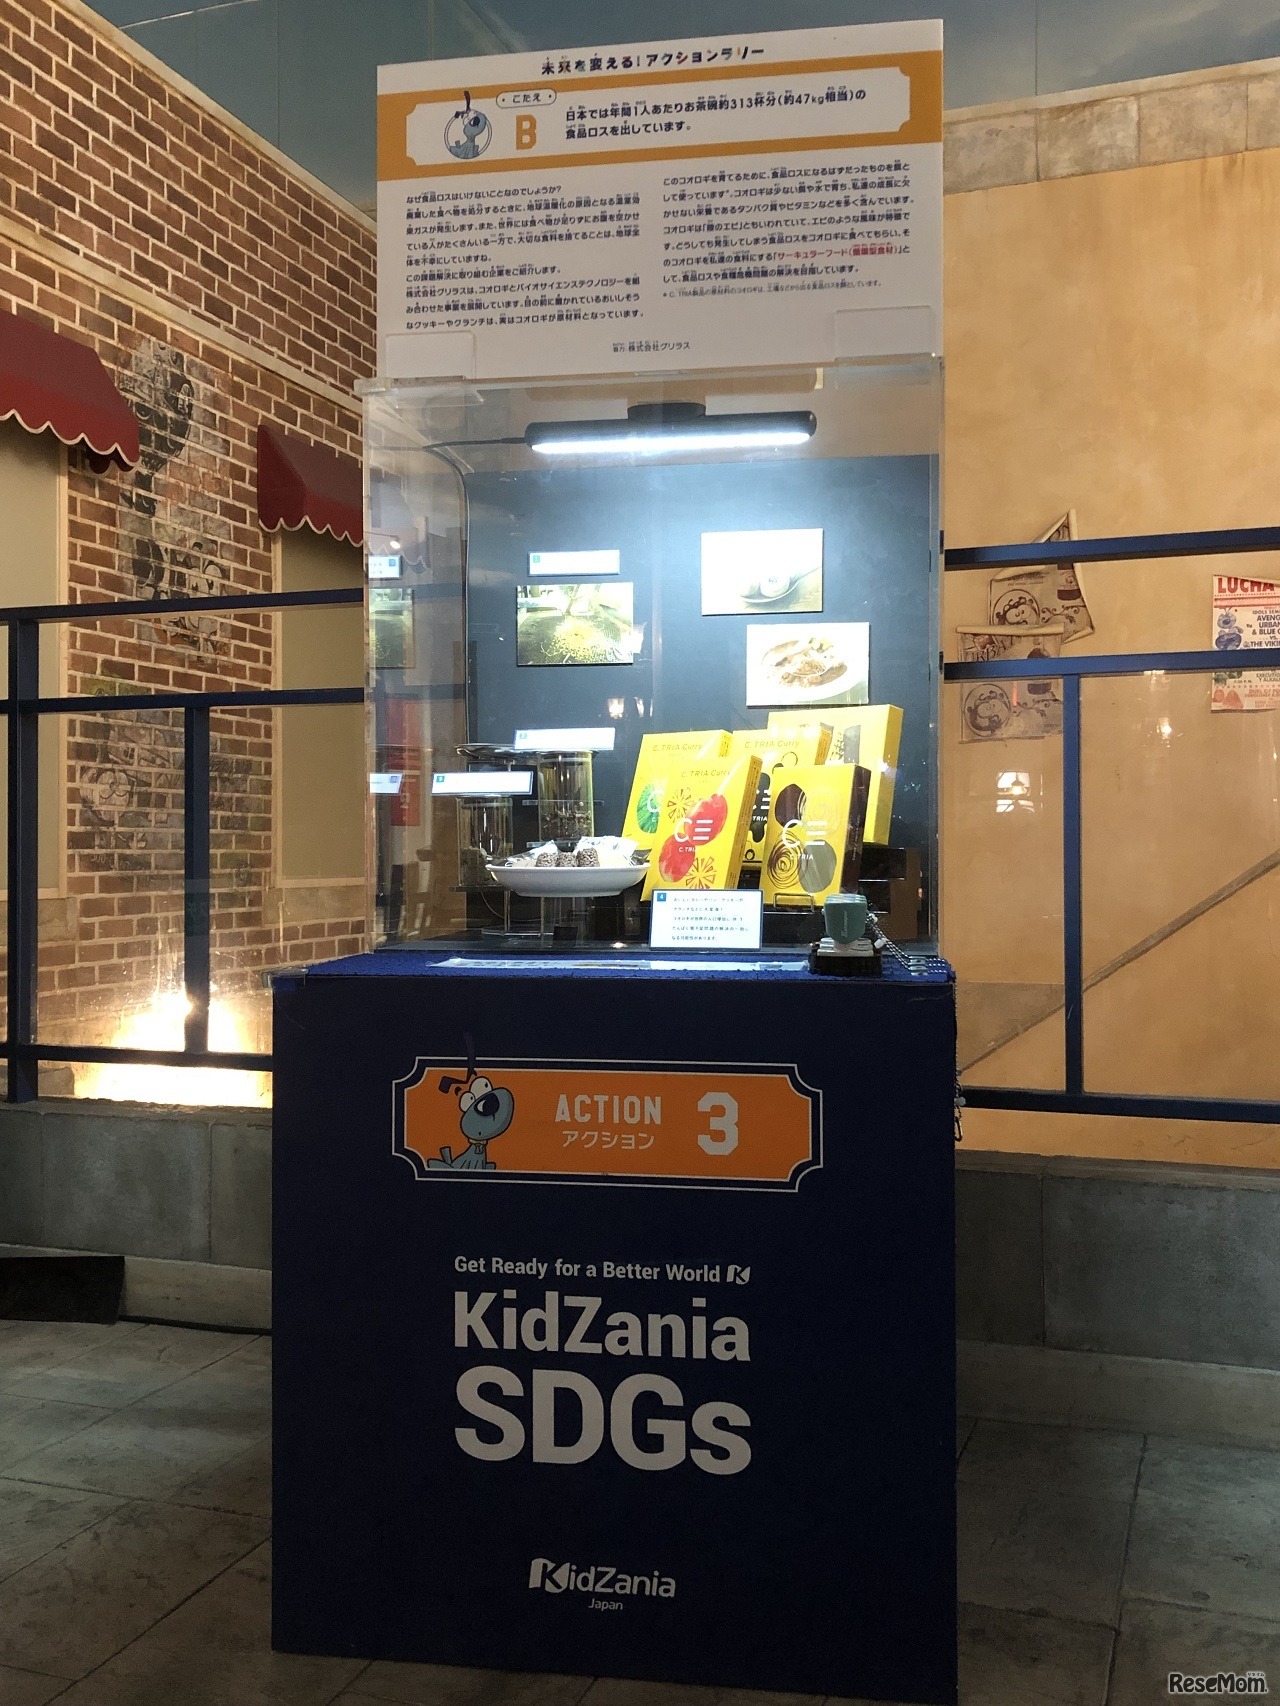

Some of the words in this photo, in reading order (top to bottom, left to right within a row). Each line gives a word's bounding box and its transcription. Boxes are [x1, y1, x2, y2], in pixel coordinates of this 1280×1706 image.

[511, 93, 542, 104] こたえ
[516, 114, 537, 150] B
[1218, 577, 1275, 594] LUCHA
[555, 1094, 662, 1125] ACTION
[697, 1091, 739, 1156] 3
[562, 1130, 655, 1150] アクション
[454, 1256, 486, 1273] Get
[491, 1257, 548, 1279] Ready
[554, 1259, 580, 1276] for
[586, 1264, 597, 1277] a
[602, 1262, 660, 1280] Better
[666, 1264, 721, 1282] World
[454, 1288, 751, 1362] KidZania
[454, 1365, 752, 1476] SDGs
[528, 1558, 676, 1598] KidZania
[588, 1598, 624, 1612] Japan
